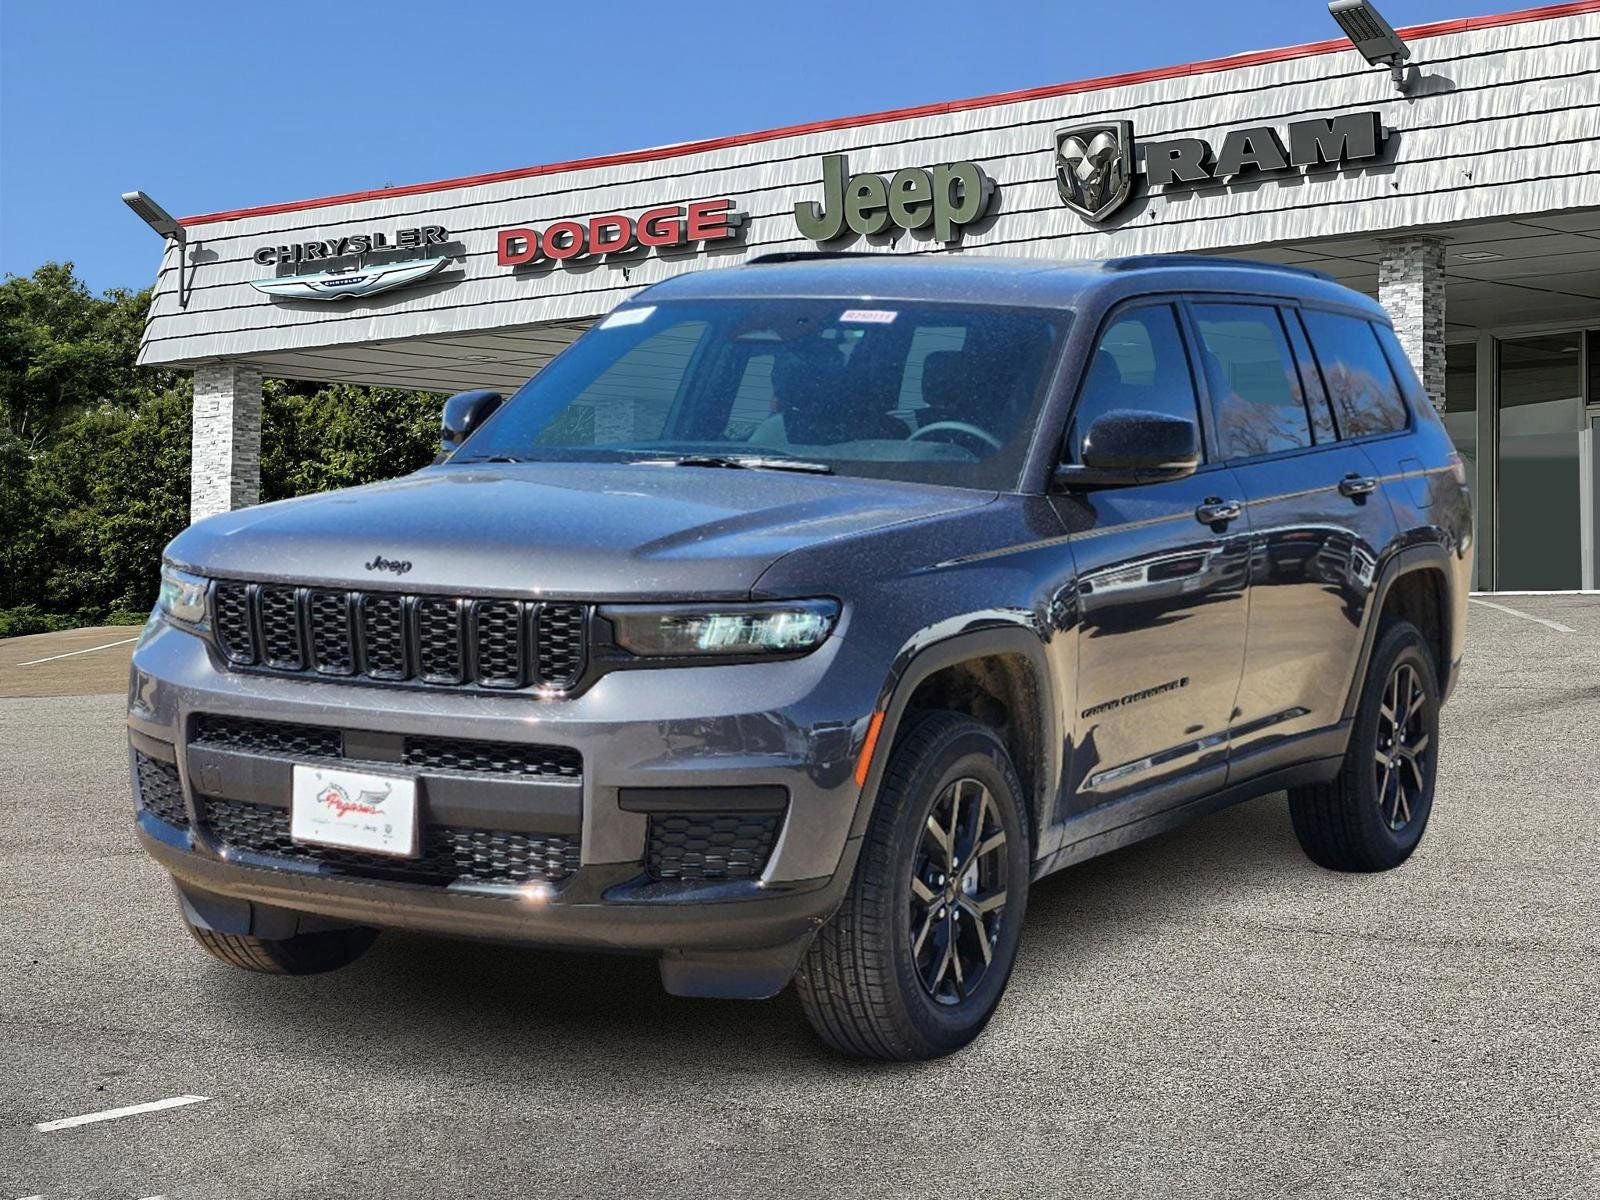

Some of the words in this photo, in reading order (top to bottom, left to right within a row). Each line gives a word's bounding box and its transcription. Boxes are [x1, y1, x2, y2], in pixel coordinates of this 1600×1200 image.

[1143, 111, 1382, 187] RAM
[497, 198, 736, 267] DODGE
[794, 153, 989, 243] Jeep
[253, 225, 448, 266] CHRYSLER
[364, 555, 413, 576] Jeep
